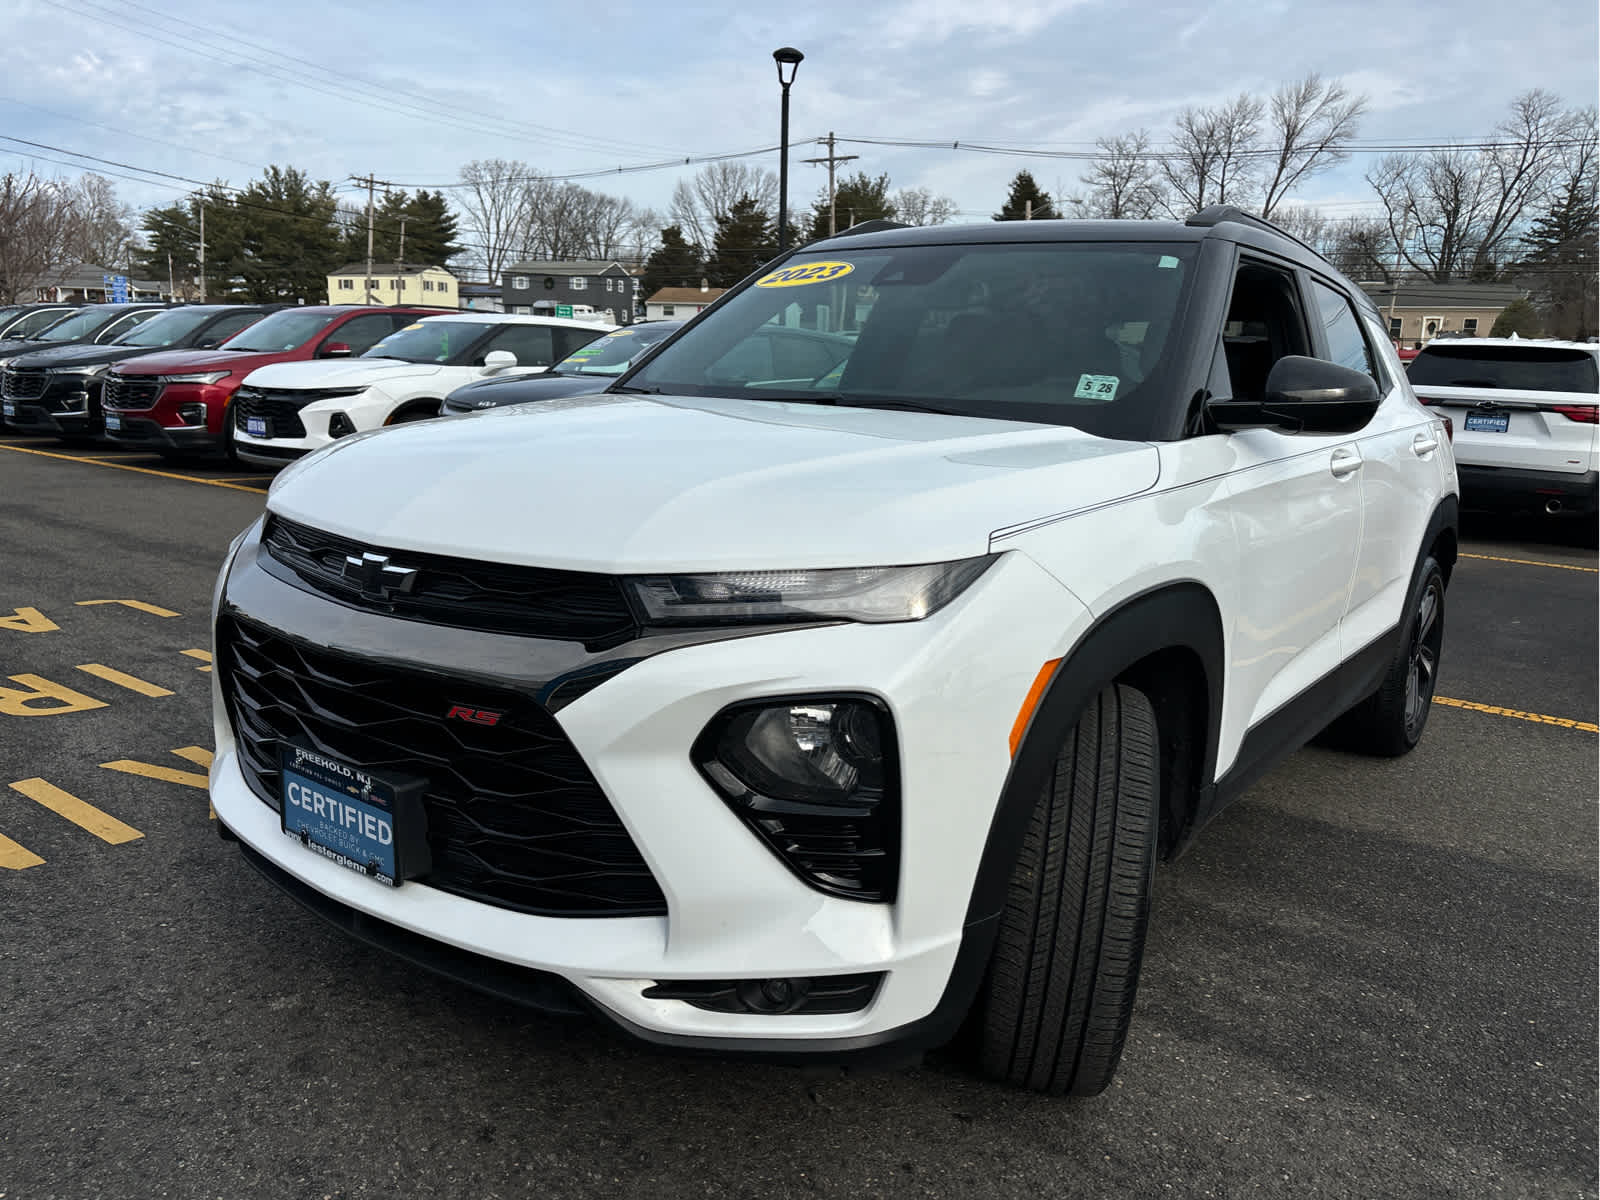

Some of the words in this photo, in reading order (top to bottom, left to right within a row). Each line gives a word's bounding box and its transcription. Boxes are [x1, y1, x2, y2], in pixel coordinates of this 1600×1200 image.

[760, 265, 846, 284] 2023
[1084, 381, 1093, 390] 5
[1097, 383, 1113, 393] 28
[1468, 418, 1507, 426] CERTIFIED
[448, 705, 501, 726] RS
[295, 748, 354, 780] FREEHOLD,
[357, 772, 371, 785] NJ
[287, 782, 393, 846] CERTIFIED
[297, 818, 338, 842] CHEVROLET
[340, 840, 361, 857] BUICK
[320, 821, 348, 840] BACKED
